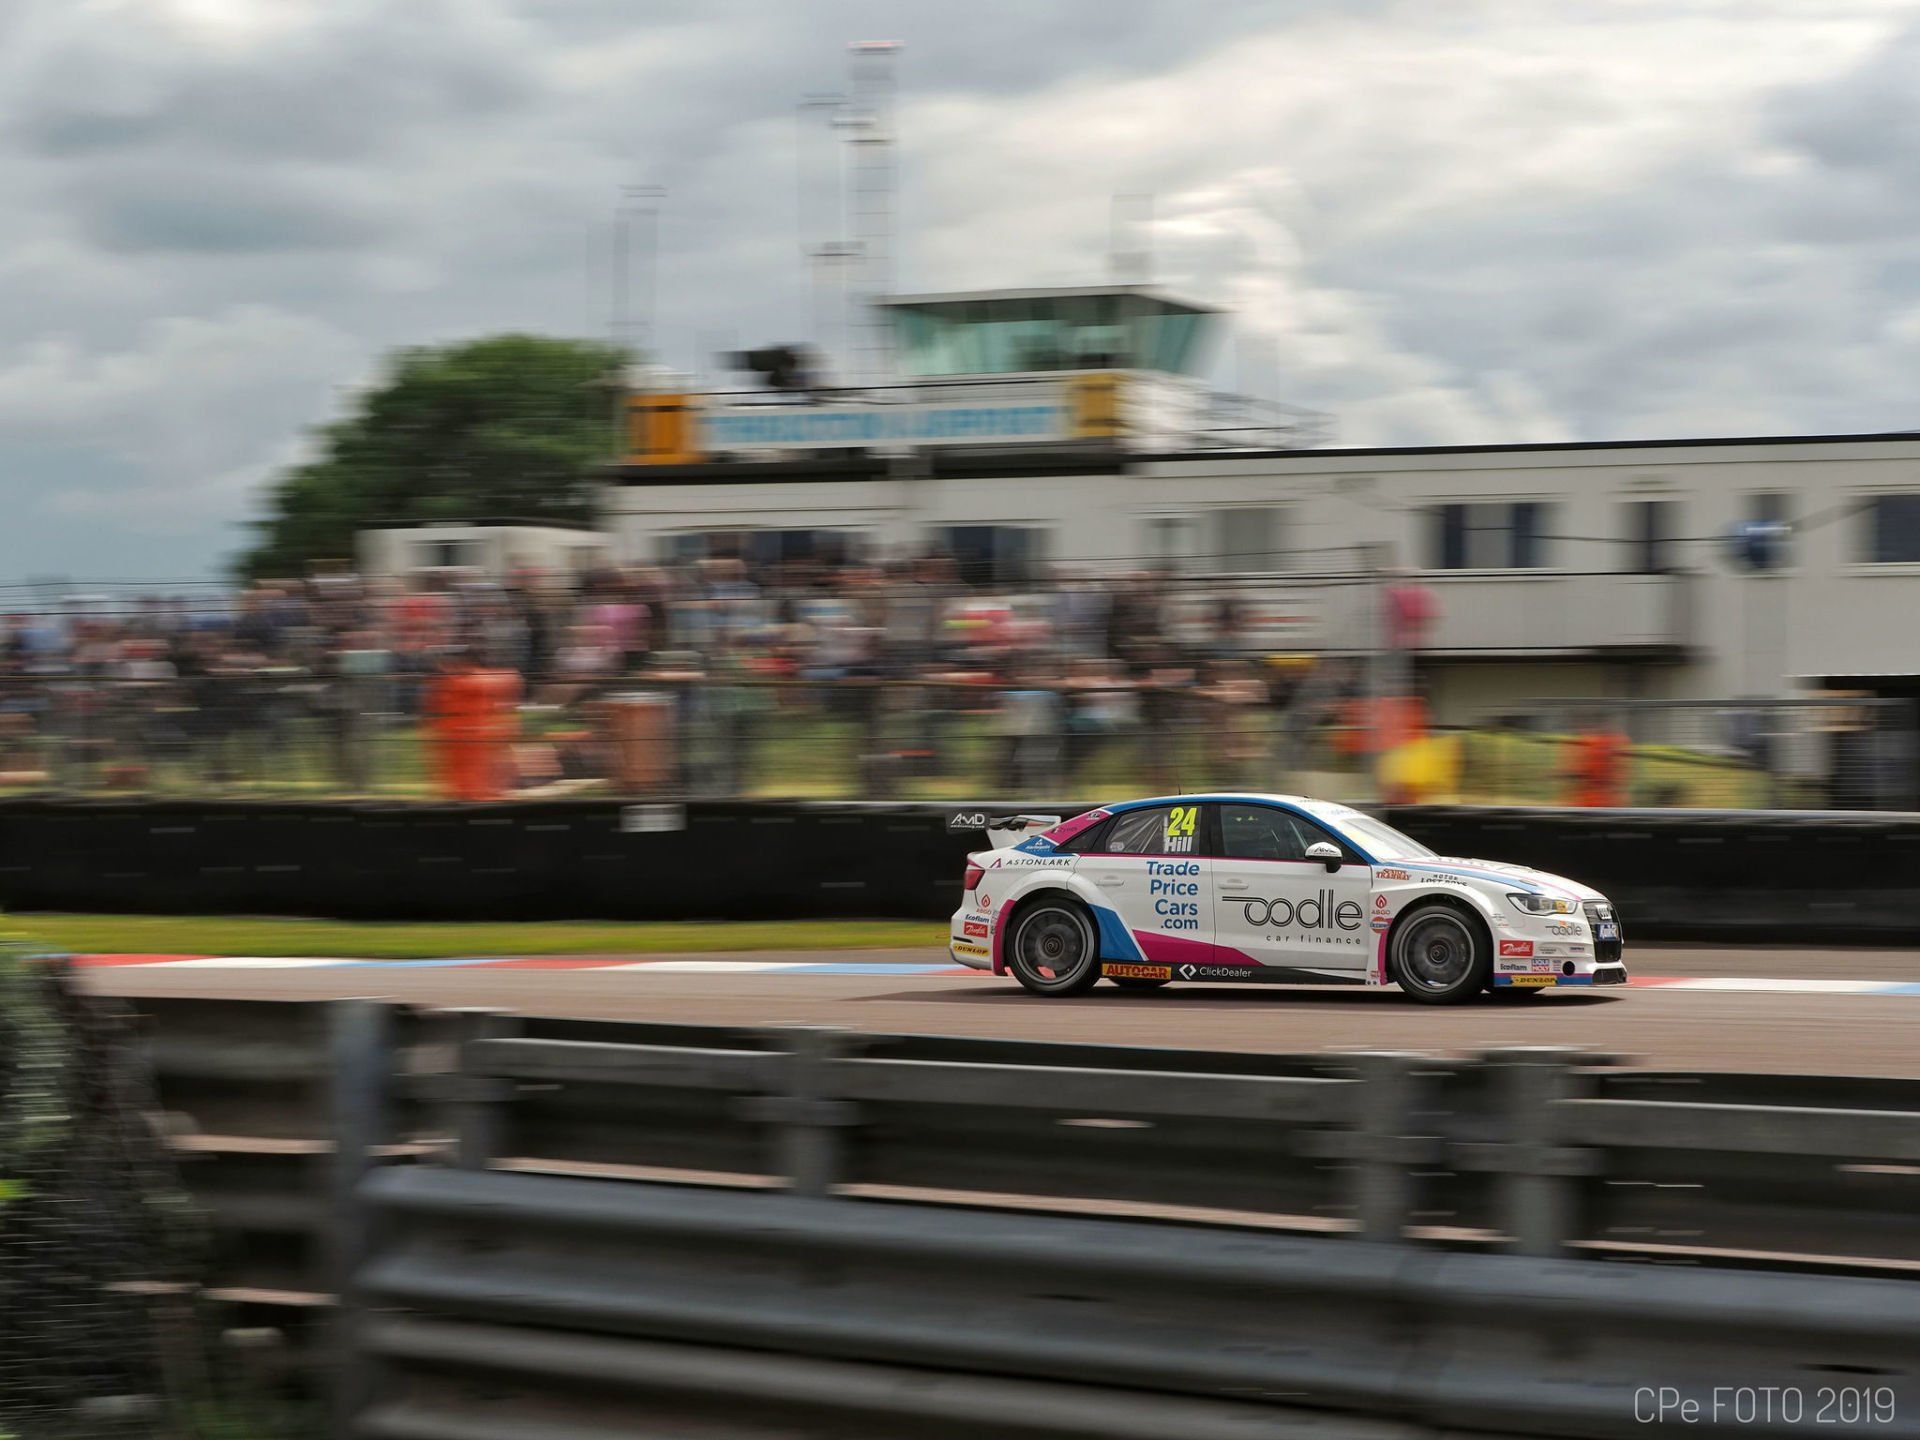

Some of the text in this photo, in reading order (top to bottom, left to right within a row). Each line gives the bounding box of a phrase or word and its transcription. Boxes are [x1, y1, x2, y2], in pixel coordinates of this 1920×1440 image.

[1167, 807, 1197, 836] 24
[1164, 836, 1193, 852] Hill
[1146, 861, 1200, 876] Trade
[1150, 879, 1198, 895] Price
[1155, 899, 1198, 916] Cars
[1160, 919, 1198, 930] .com
[1266, 934, 1361, 945] car finance
[1106, 964, 1168, 979] AUTOCAR
[1200, 967, 1252, 977] ClickDealer
